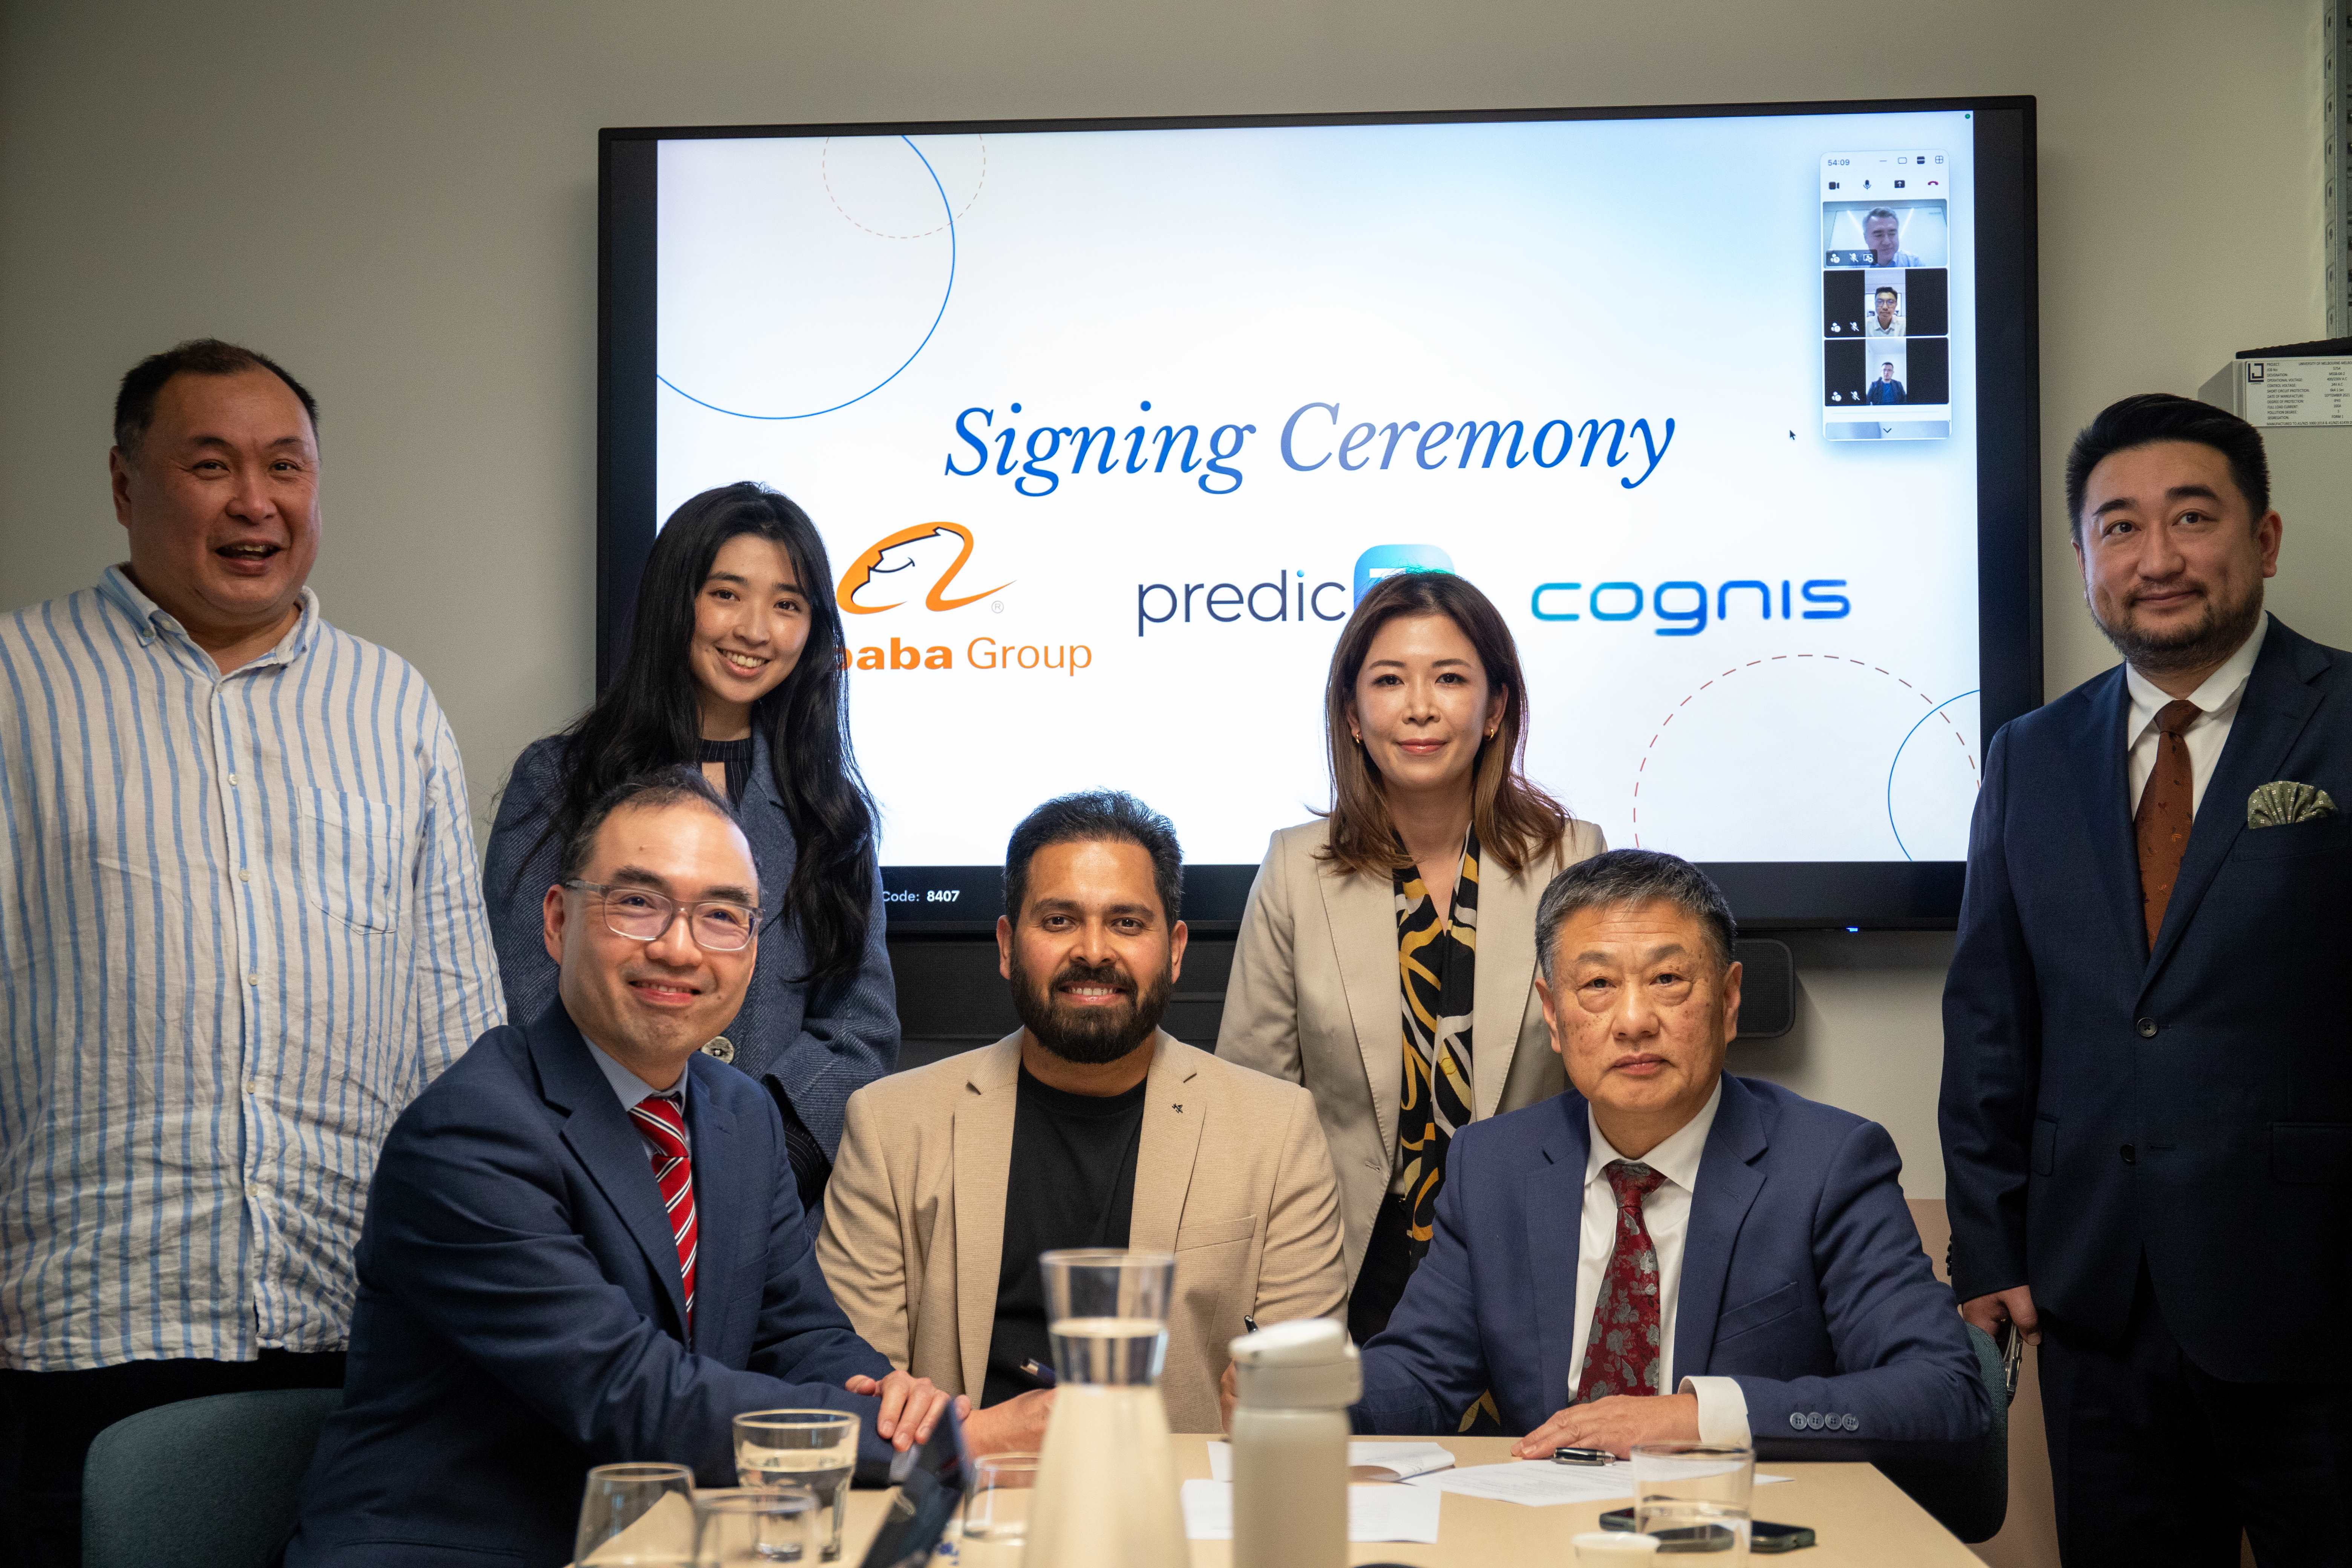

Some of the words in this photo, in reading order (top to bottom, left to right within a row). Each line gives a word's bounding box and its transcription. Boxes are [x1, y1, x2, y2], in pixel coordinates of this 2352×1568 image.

[945, 401, 1257, 497] Signing
[1281, 402, 1676, 489] Ceremony
[1138, 568, 1406, 637] predic
[1531, 579, 1851, 636] cognis
[967, 637, 1092, 677] Group
[883, 890, 920, 902] Code:
[926, 890, 960, 902] 8407
